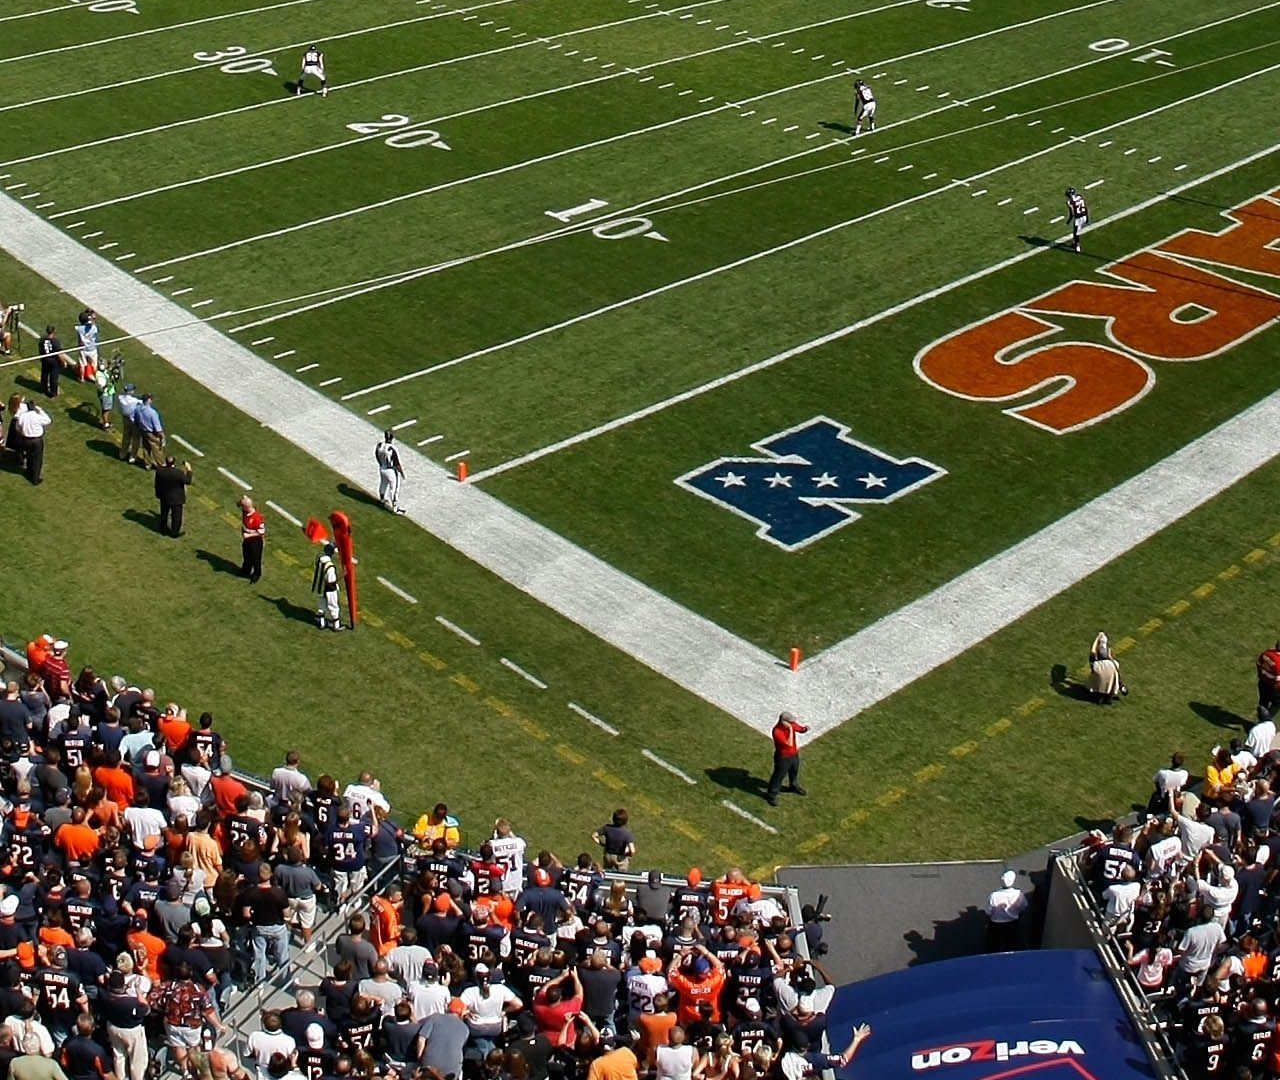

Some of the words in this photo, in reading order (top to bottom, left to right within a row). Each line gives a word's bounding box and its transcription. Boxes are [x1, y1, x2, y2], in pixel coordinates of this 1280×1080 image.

[193, 44, 274, 76] 30
[1087, 37, 1174, 67] 10
[346, 113, 442, 151] 20
[544, 197, 654, 242] 10
[673, 415, 948, 551] N
[66, 749, 83, 767] 51
[196, 743, 214, 758] 54
[318, 806, 328, 823] 6
[352, 802, 362, 820] 6
[333, 843, 358, 861] 34
[568, 882, 589, 905] 54
[1143, 920, 1162, 934] 23
[529, 974, 551, 984] CUTLE
[738, 976, 762, 985] HESTER
[45, 985, 71, 1009] 54
[631, 993, 654, 1013] 22
[911, 1040, 1085, 1070] verizon
[1252, 1042, 1265, 1060] 6
[1207, 1054, 1220, 1071] 9
